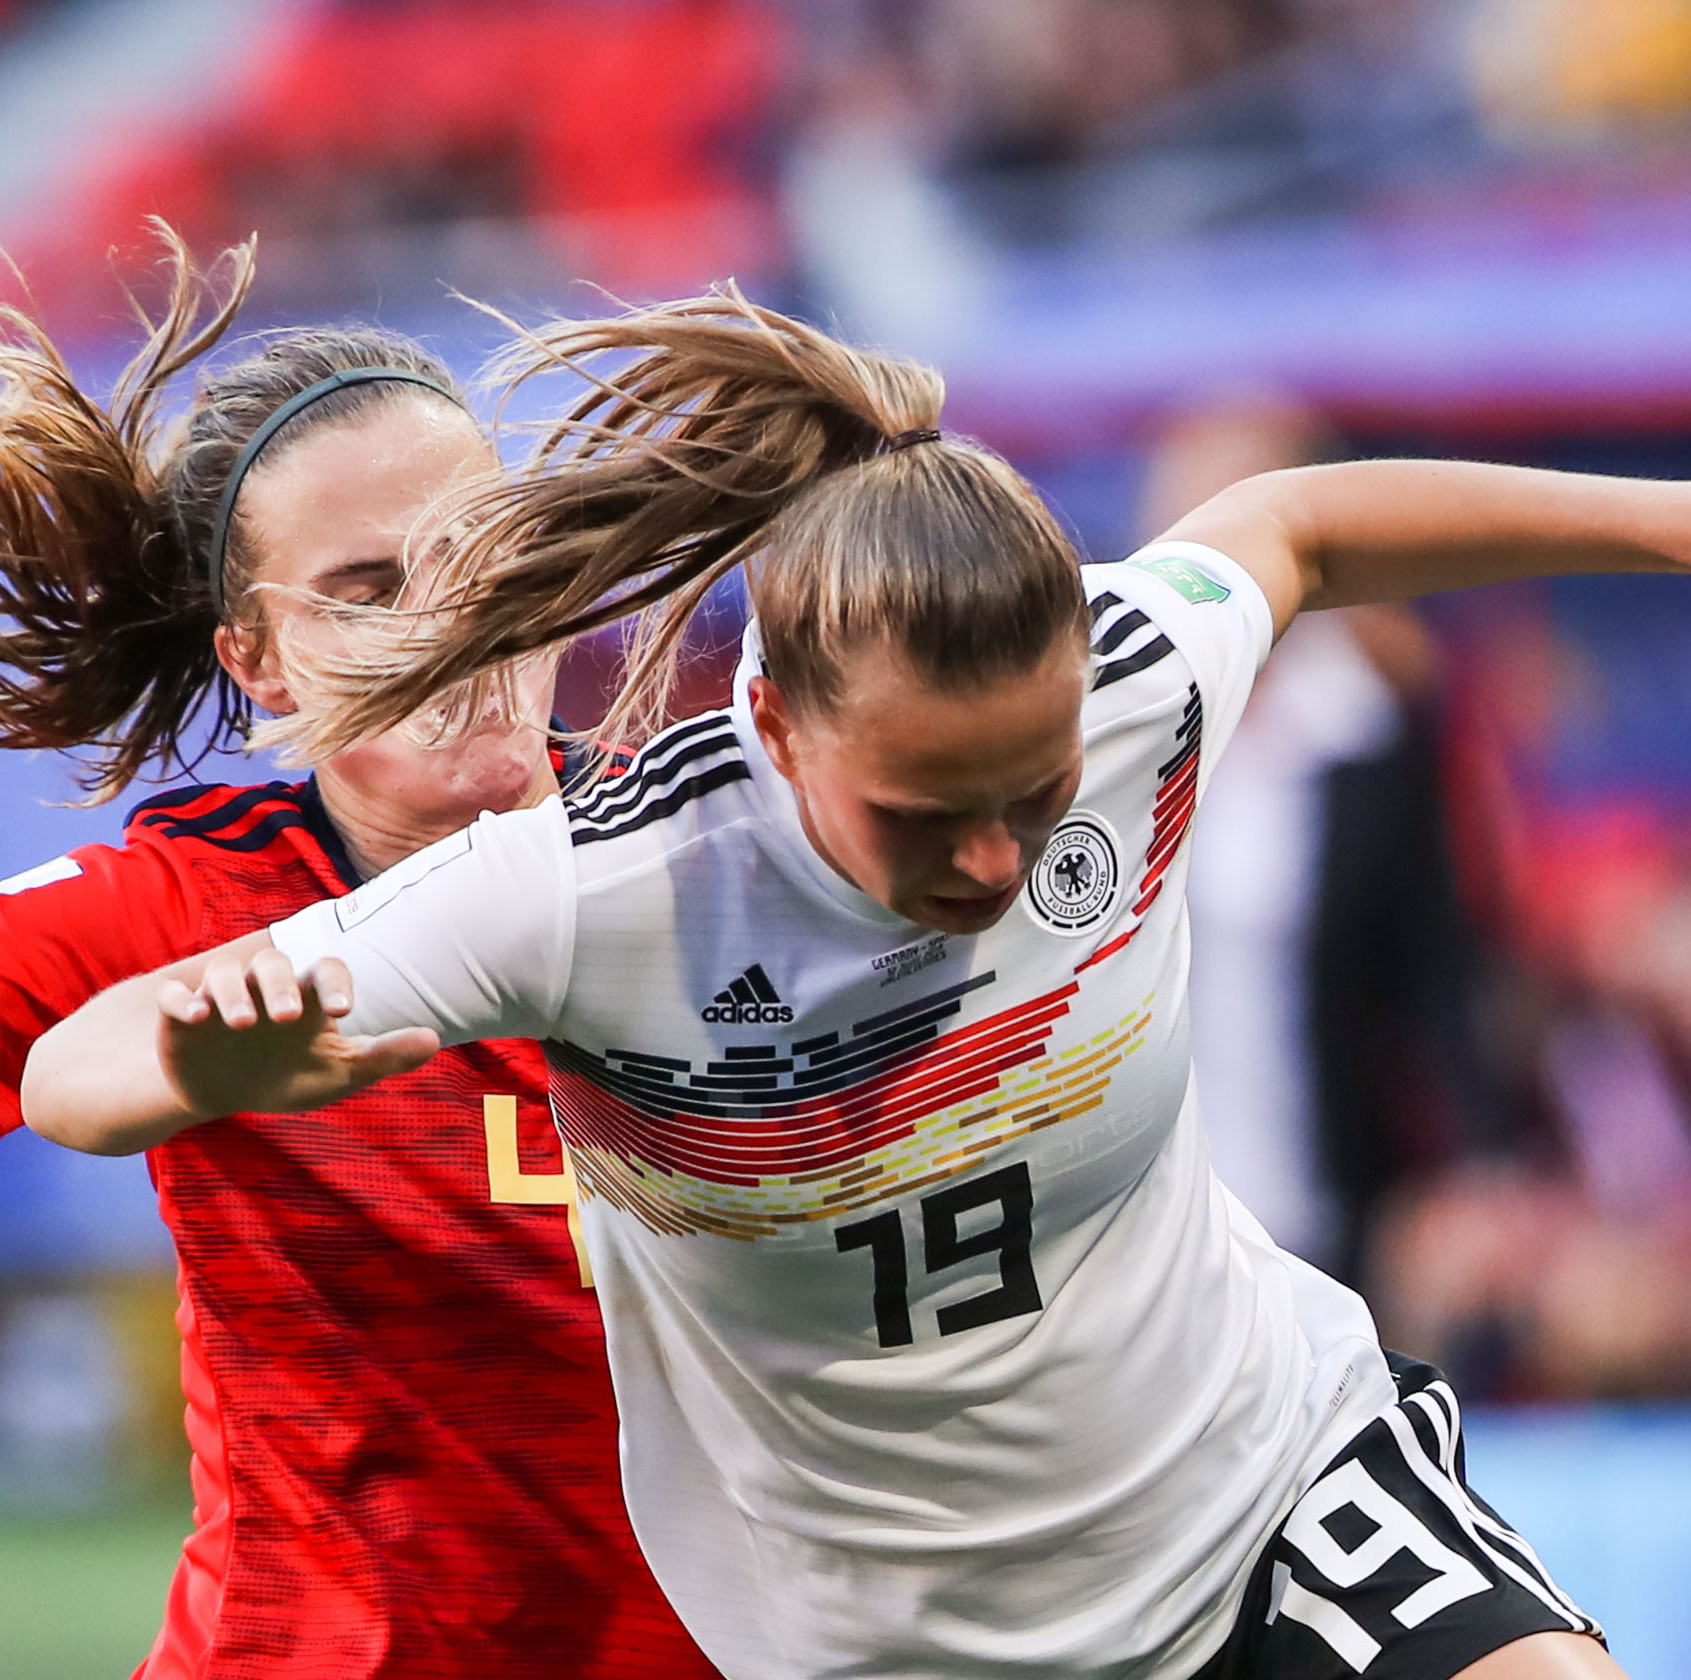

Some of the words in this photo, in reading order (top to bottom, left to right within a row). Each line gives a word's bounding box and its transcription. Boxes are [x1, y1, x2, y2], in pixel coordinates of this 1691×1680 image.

[1042, 835, 1090, 867] DEUTSCHER
[701, 1003, 794, 1024] adidas
[483, 1094, 596, 1288] 4
[834, 1160, 1044, 1348] 19
[1264, 1457, 1494, 1674] 19
